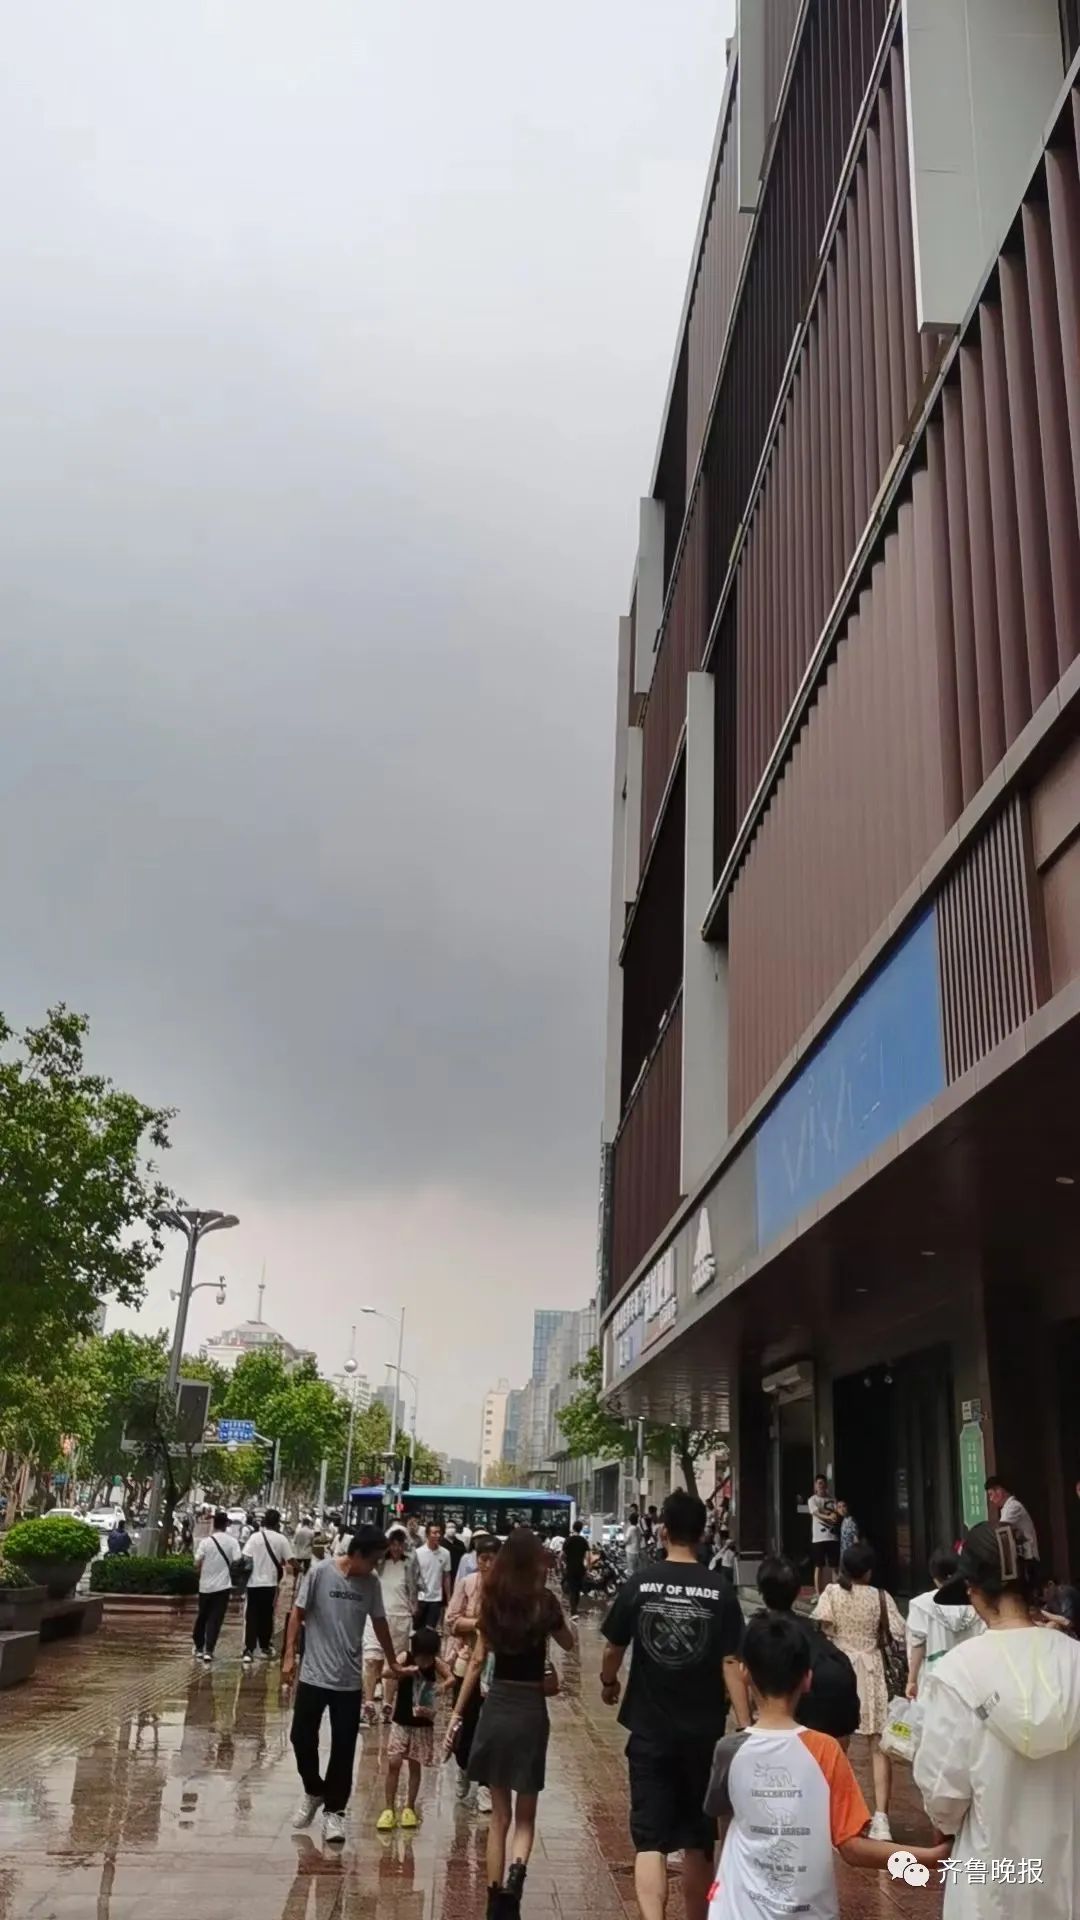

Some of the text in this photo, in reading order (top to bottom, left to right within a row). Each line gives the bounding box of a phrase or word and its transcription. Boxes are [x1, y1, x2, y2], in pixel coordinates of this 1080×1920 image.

[640, 1583, 720, 1600] WAY OF WADE
